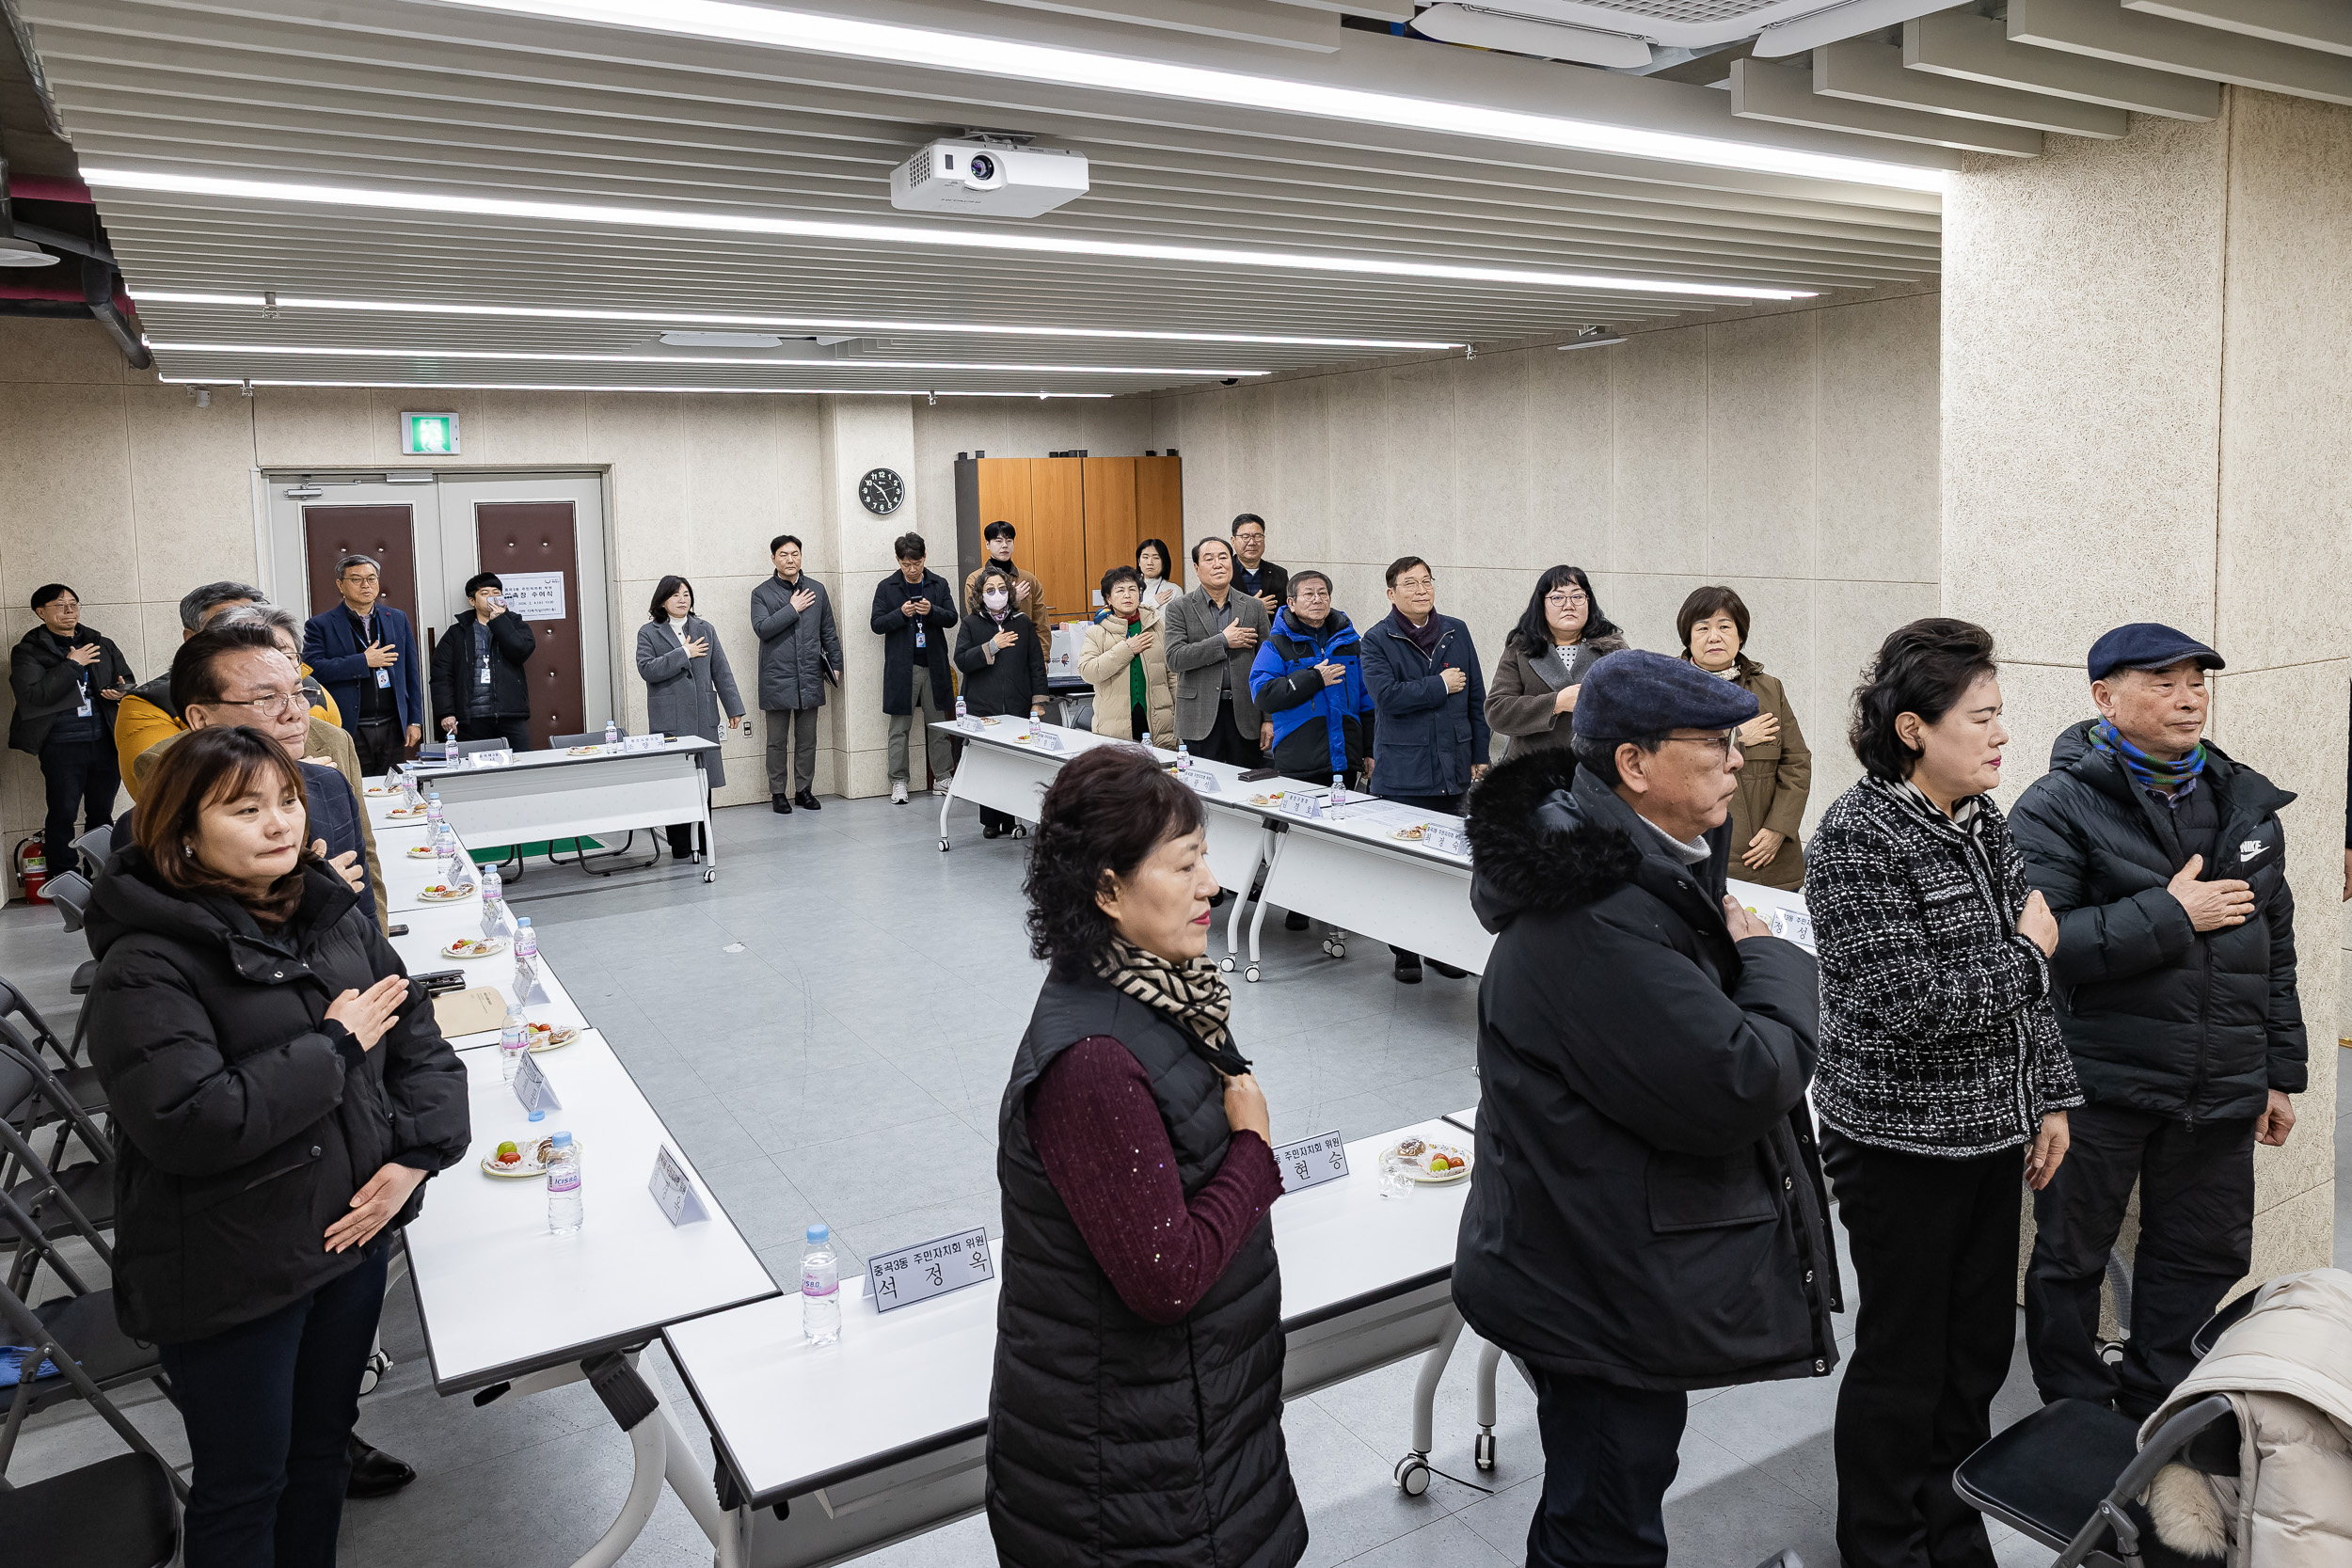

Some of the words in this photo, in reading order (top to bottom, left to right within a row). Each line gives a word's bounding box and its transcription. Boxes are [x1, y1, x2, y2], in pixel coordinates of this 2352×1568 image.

[2240, 840, 2262, 852] NIKE
[1285, 1142, 1322, 1161] 주민자치회
[1325, 1137, 1340, 1148] 위원
[1295, 1160, 1311, 1180] 현
[1328, 1151, 1343, 1170] 승
[874, 1257, 909, 1276] 중곡3동
[914, 1242, 961, 1264] 주민자치회
[965, 1234, 985, 1249] 위원
[878, 1276, 898, 1299] 석
[925, 1262, 943, 1286] 정
[969, 1251, 987, 1272] 옥
